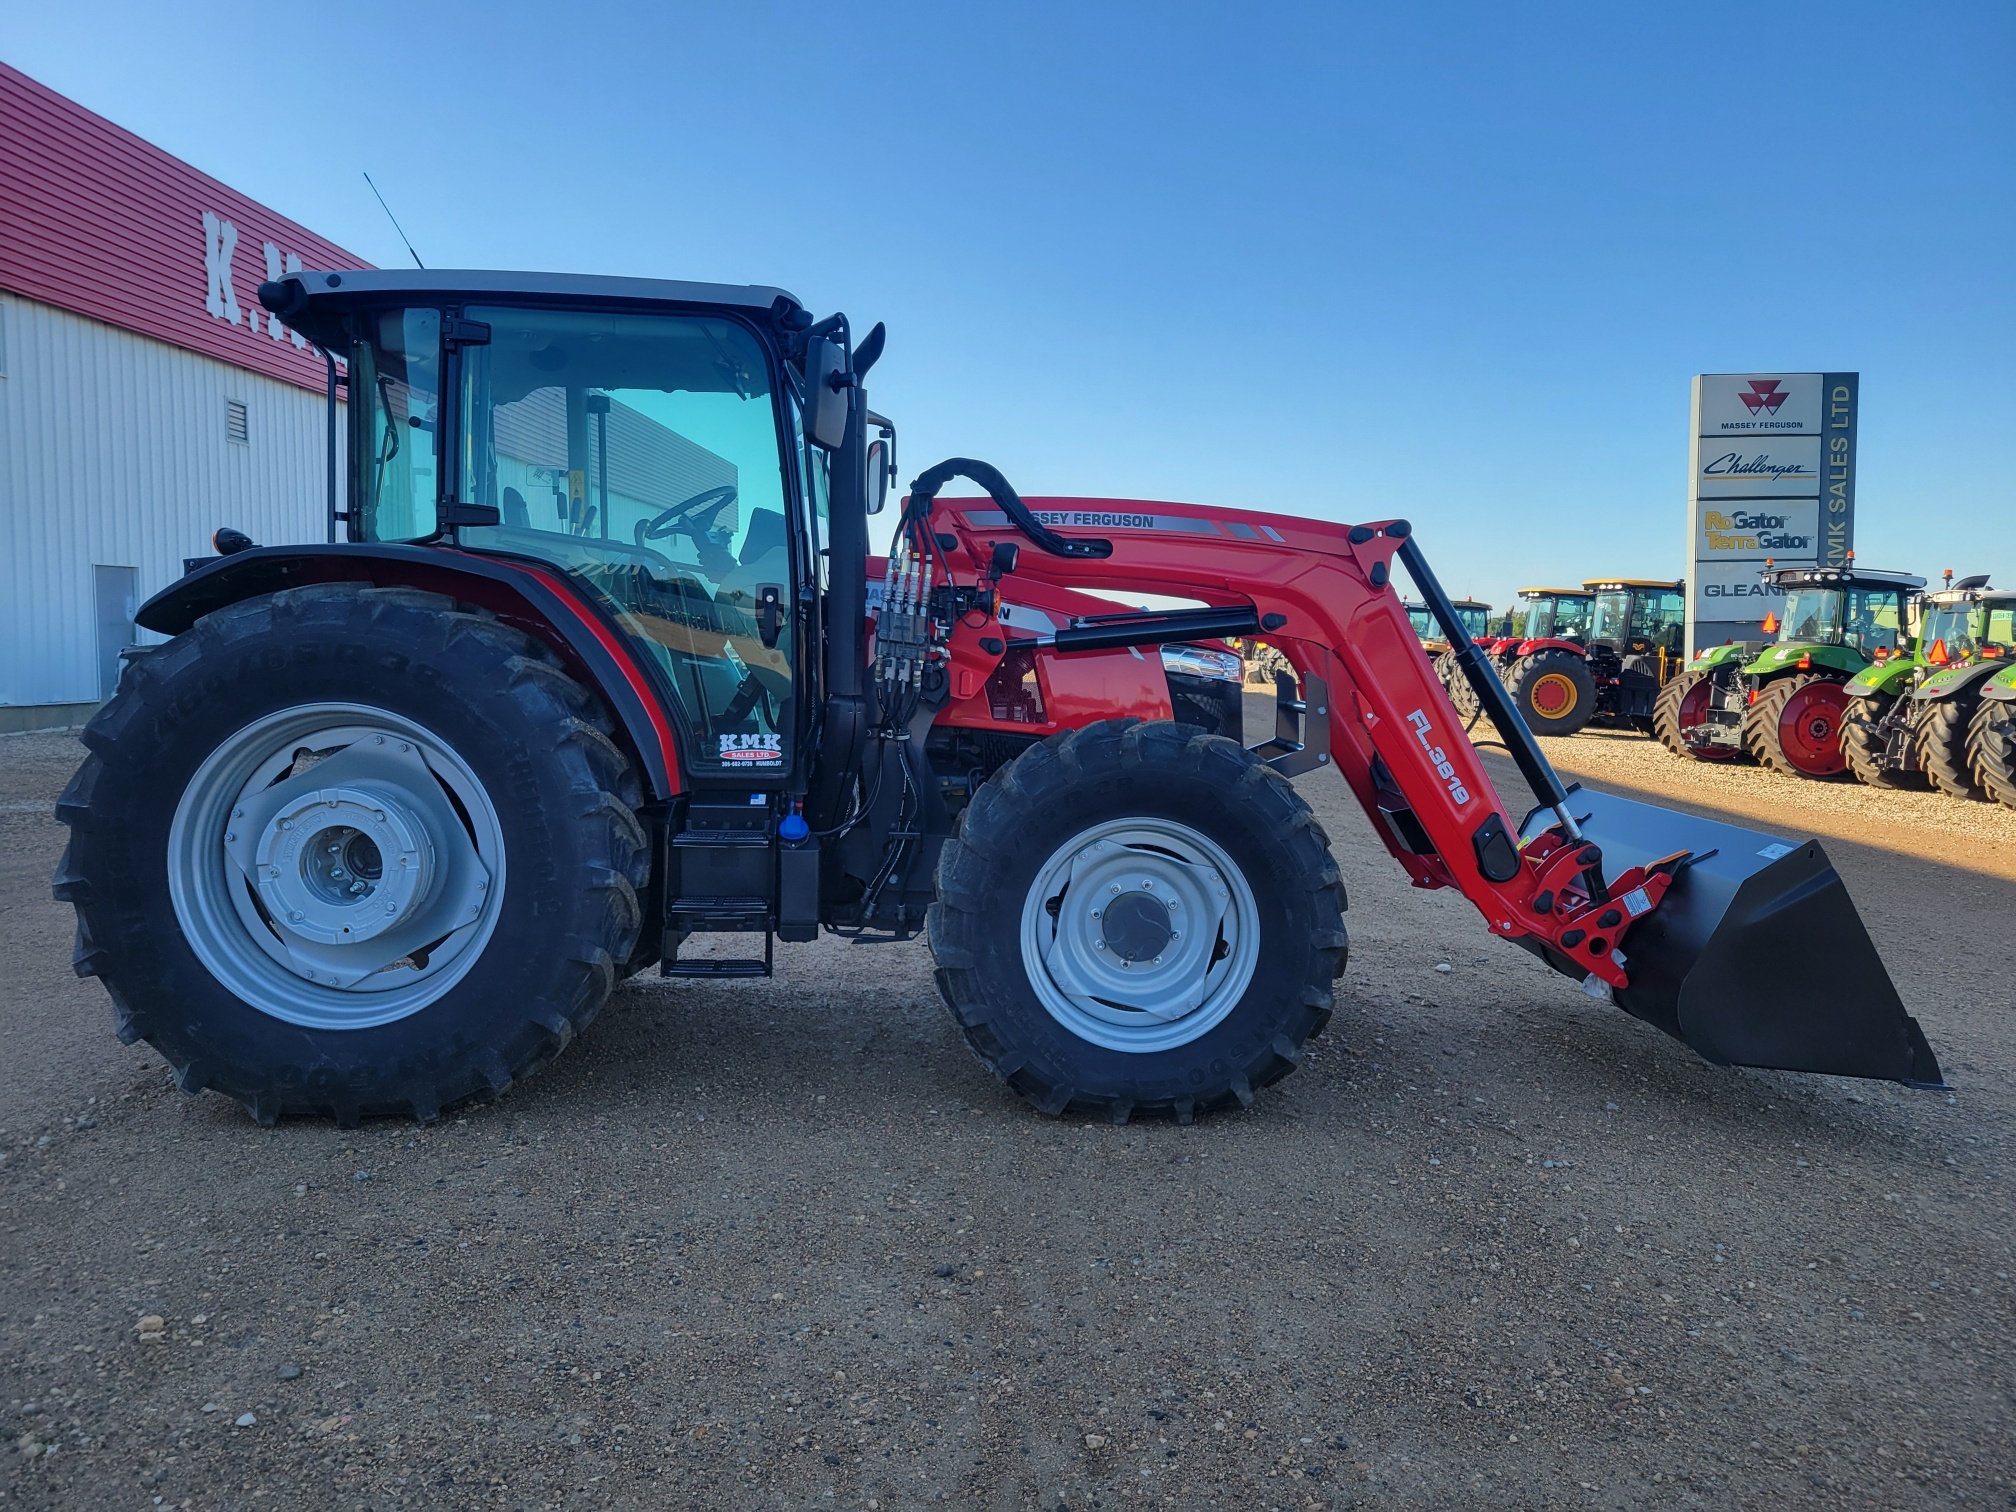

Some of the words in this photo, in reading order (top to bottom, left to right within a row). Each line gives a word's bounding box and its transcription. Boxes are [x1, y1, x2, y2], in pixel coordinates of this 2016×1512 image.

[1831, 385, 1850, 429] LTD
[1721, 421, 1757, 430] MASSEY
[1759, 421, 1803, 429] FERGUSON
[1703, 452, 1817, 481] Challenger
[1829, 437, 1848, 514] SALES
[1073, 512, 1154, 528] FERGUSON
[1705, 510, 1788, 531] RoGator
[1704, 530, 1811, 550] TerraGator
[720, 733, 781, 752] K.M.K
[1406, 708, 1471, 805] FL.3819
